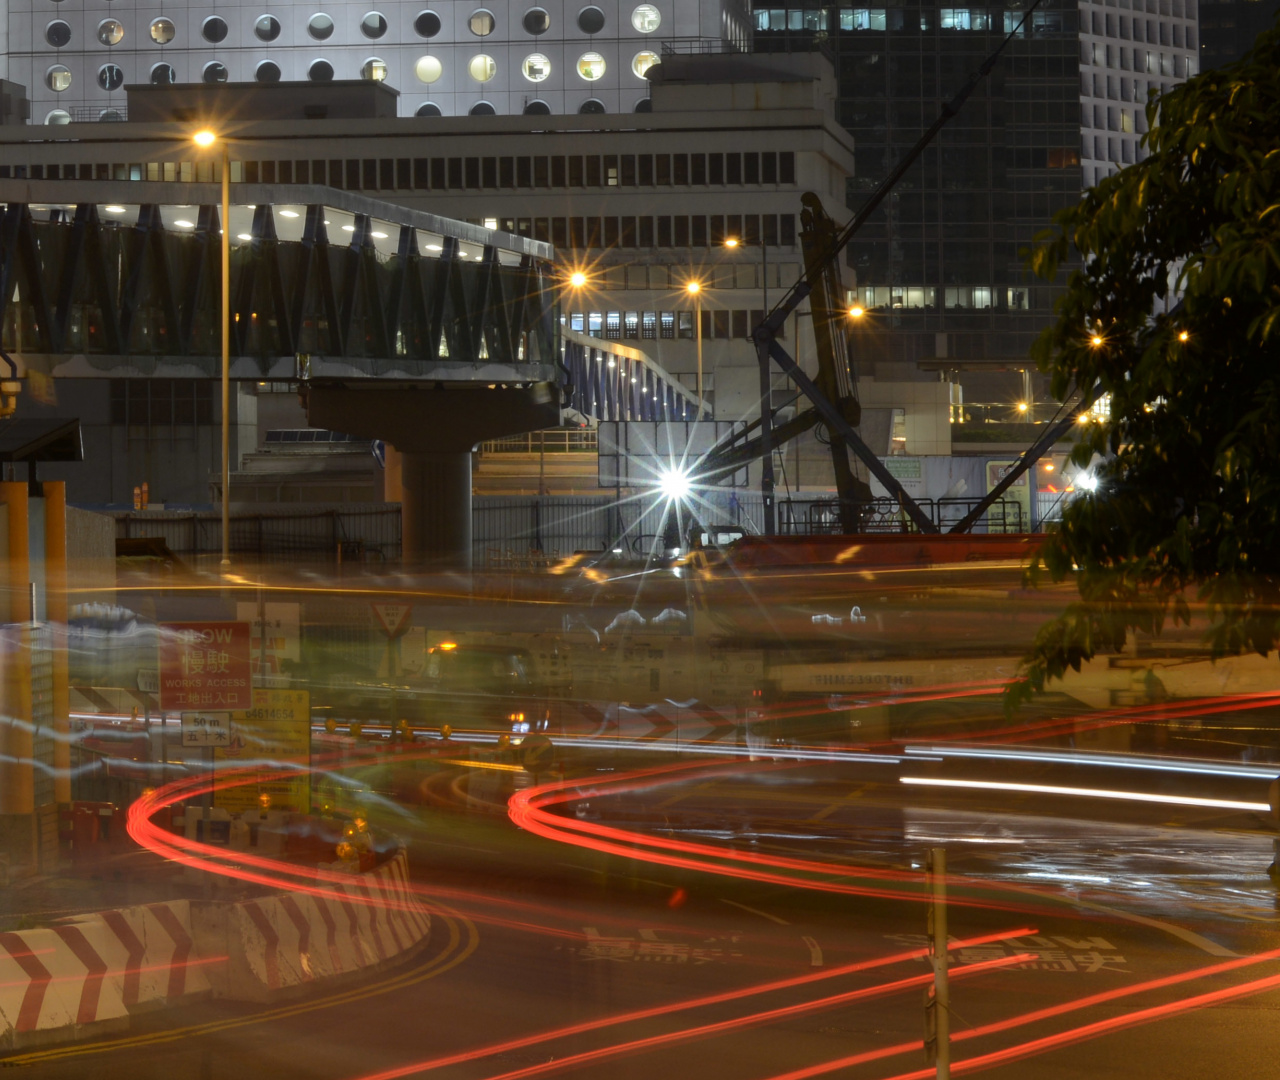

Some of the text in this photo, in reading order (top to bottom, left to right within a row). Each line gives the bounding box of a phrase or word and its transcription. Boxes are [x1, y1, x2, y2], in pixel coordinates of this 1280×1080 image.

[182, 650, 229, 674] 慢駛
[166, 679, 201, 688] WORKS
[207, 679, 246, 687] ACCESS
[176, 692, 238, 705] 工地出入口
[194, 718, 208, 727] 50
[187, 730, 226, 741] 五十米
